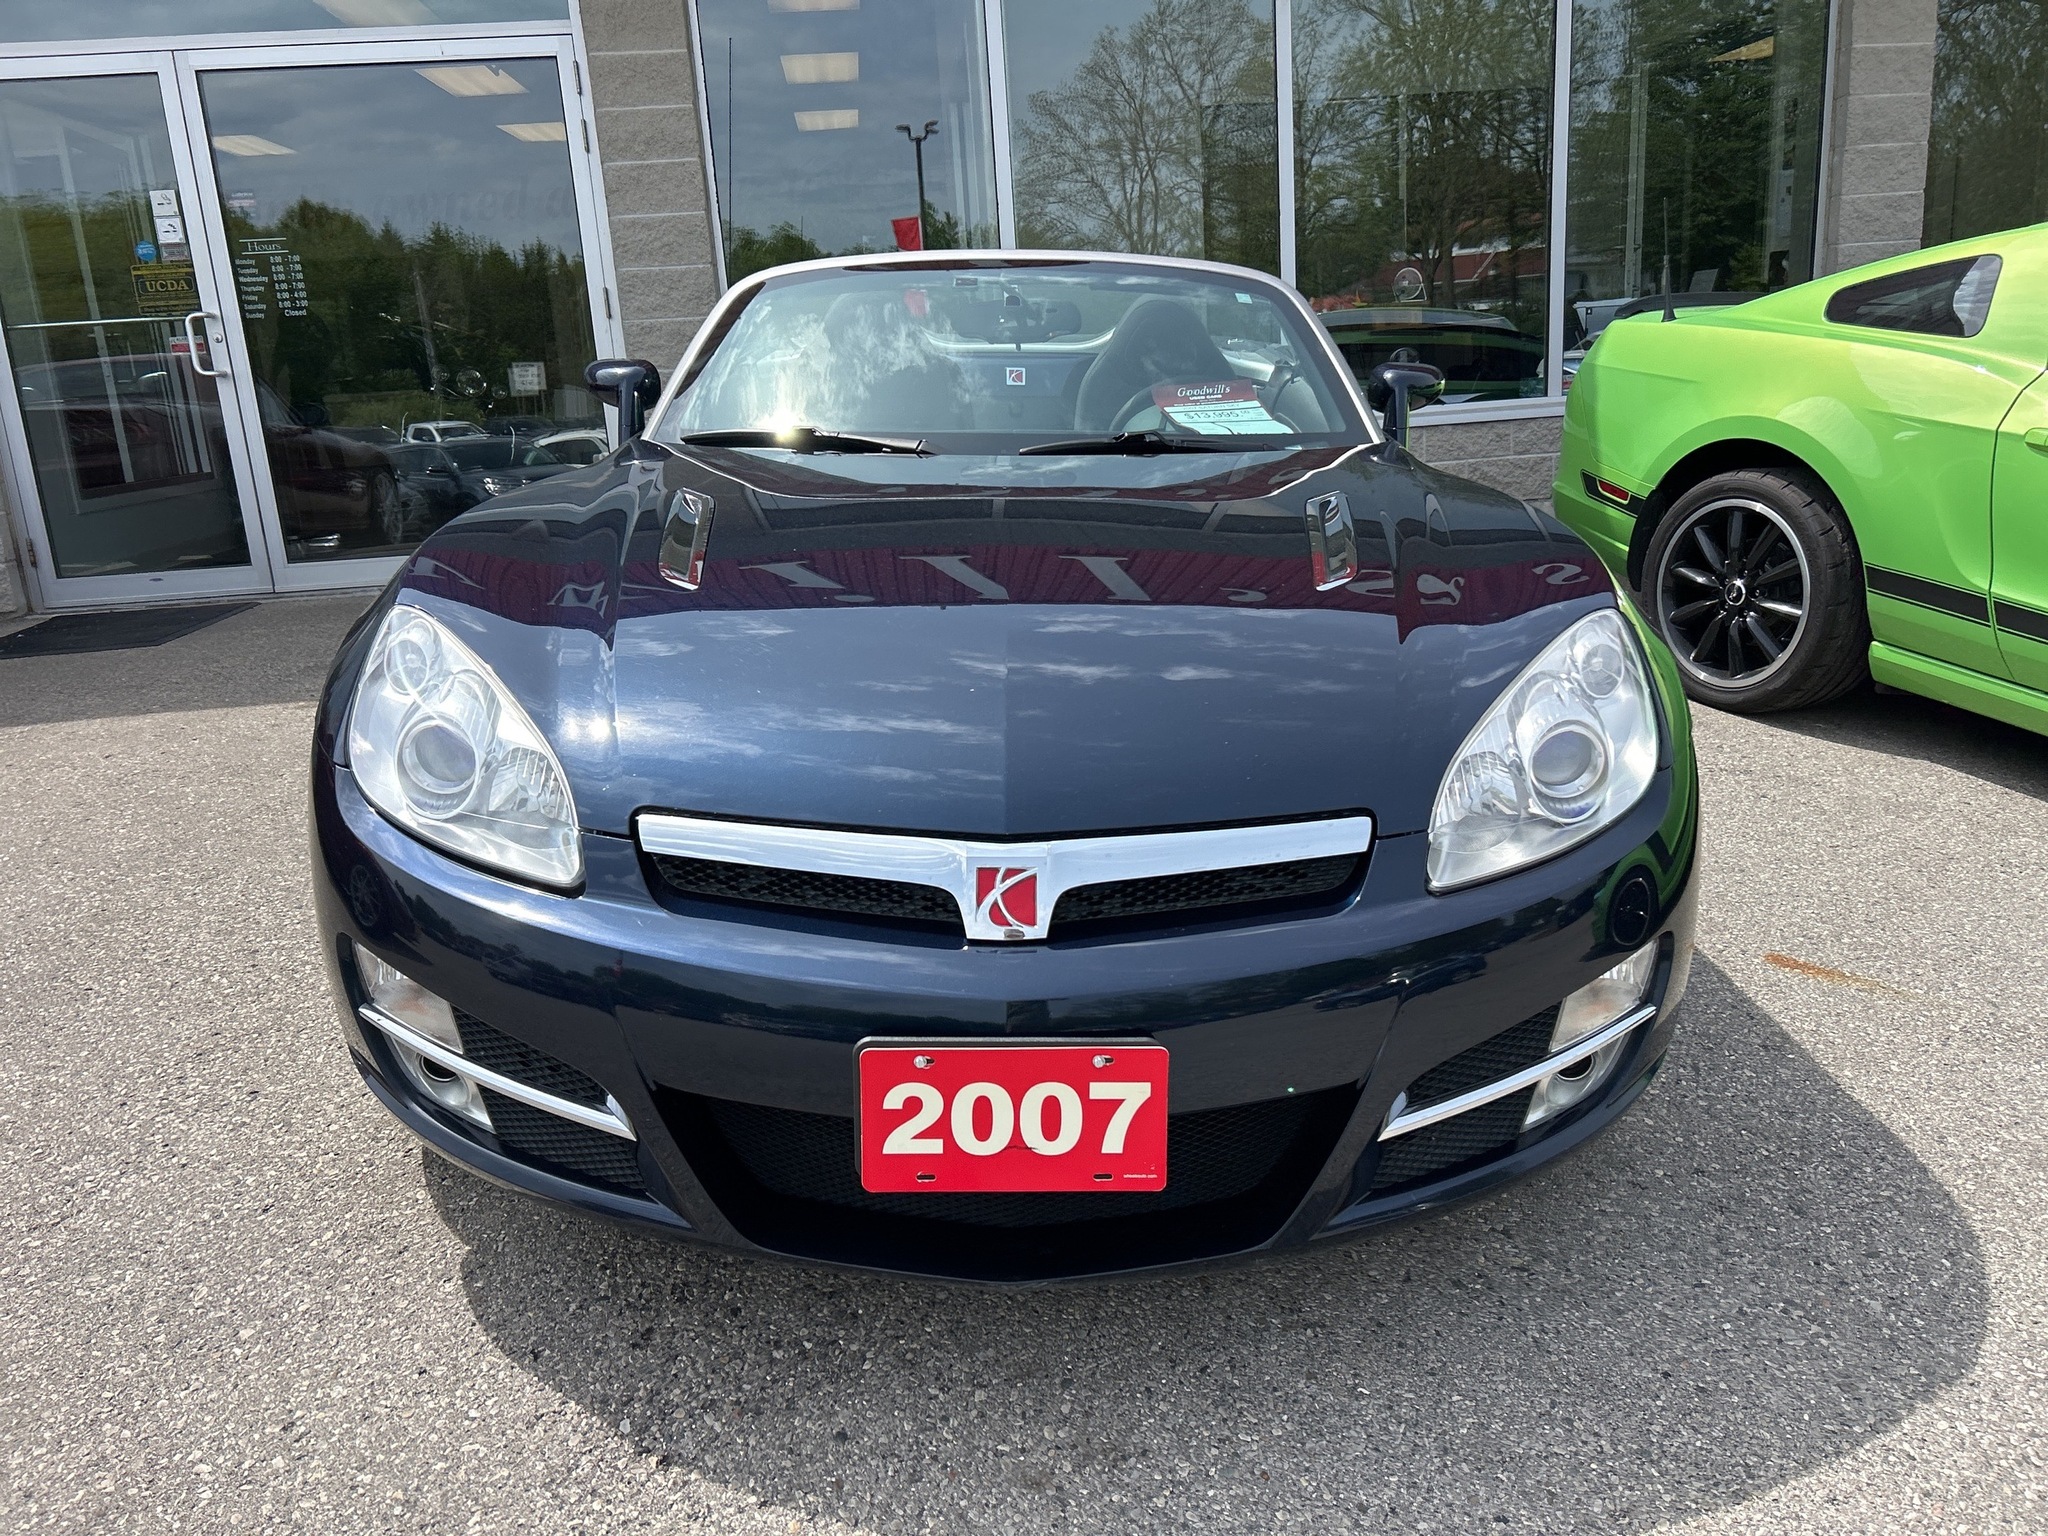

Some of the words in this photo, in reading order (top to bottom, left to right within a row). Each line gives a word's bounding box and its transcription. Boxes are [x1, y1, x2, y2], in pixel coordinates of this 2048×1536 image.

[247, 242, 282, 251] Hours
[270, 255, 282, 263] 8:00
[288, 254, 300, 262] 7:00
[237, 267, 258, 275] Tuesday
[289, 263, 302, 271] 7:00
[273, 273, 285, 281] 8:00
[291, 272, 304, 280] 7:00
[145, 280, 190, 292] UCDA
[275, 282, 288, 290] 8:00
[292, 281, 305, 289] 7:00
[284, 309, 307, 317] Closed
[1177, 384, 1231, 397] Goodwill's
[882, 1081, 1152, 1156] 2007
